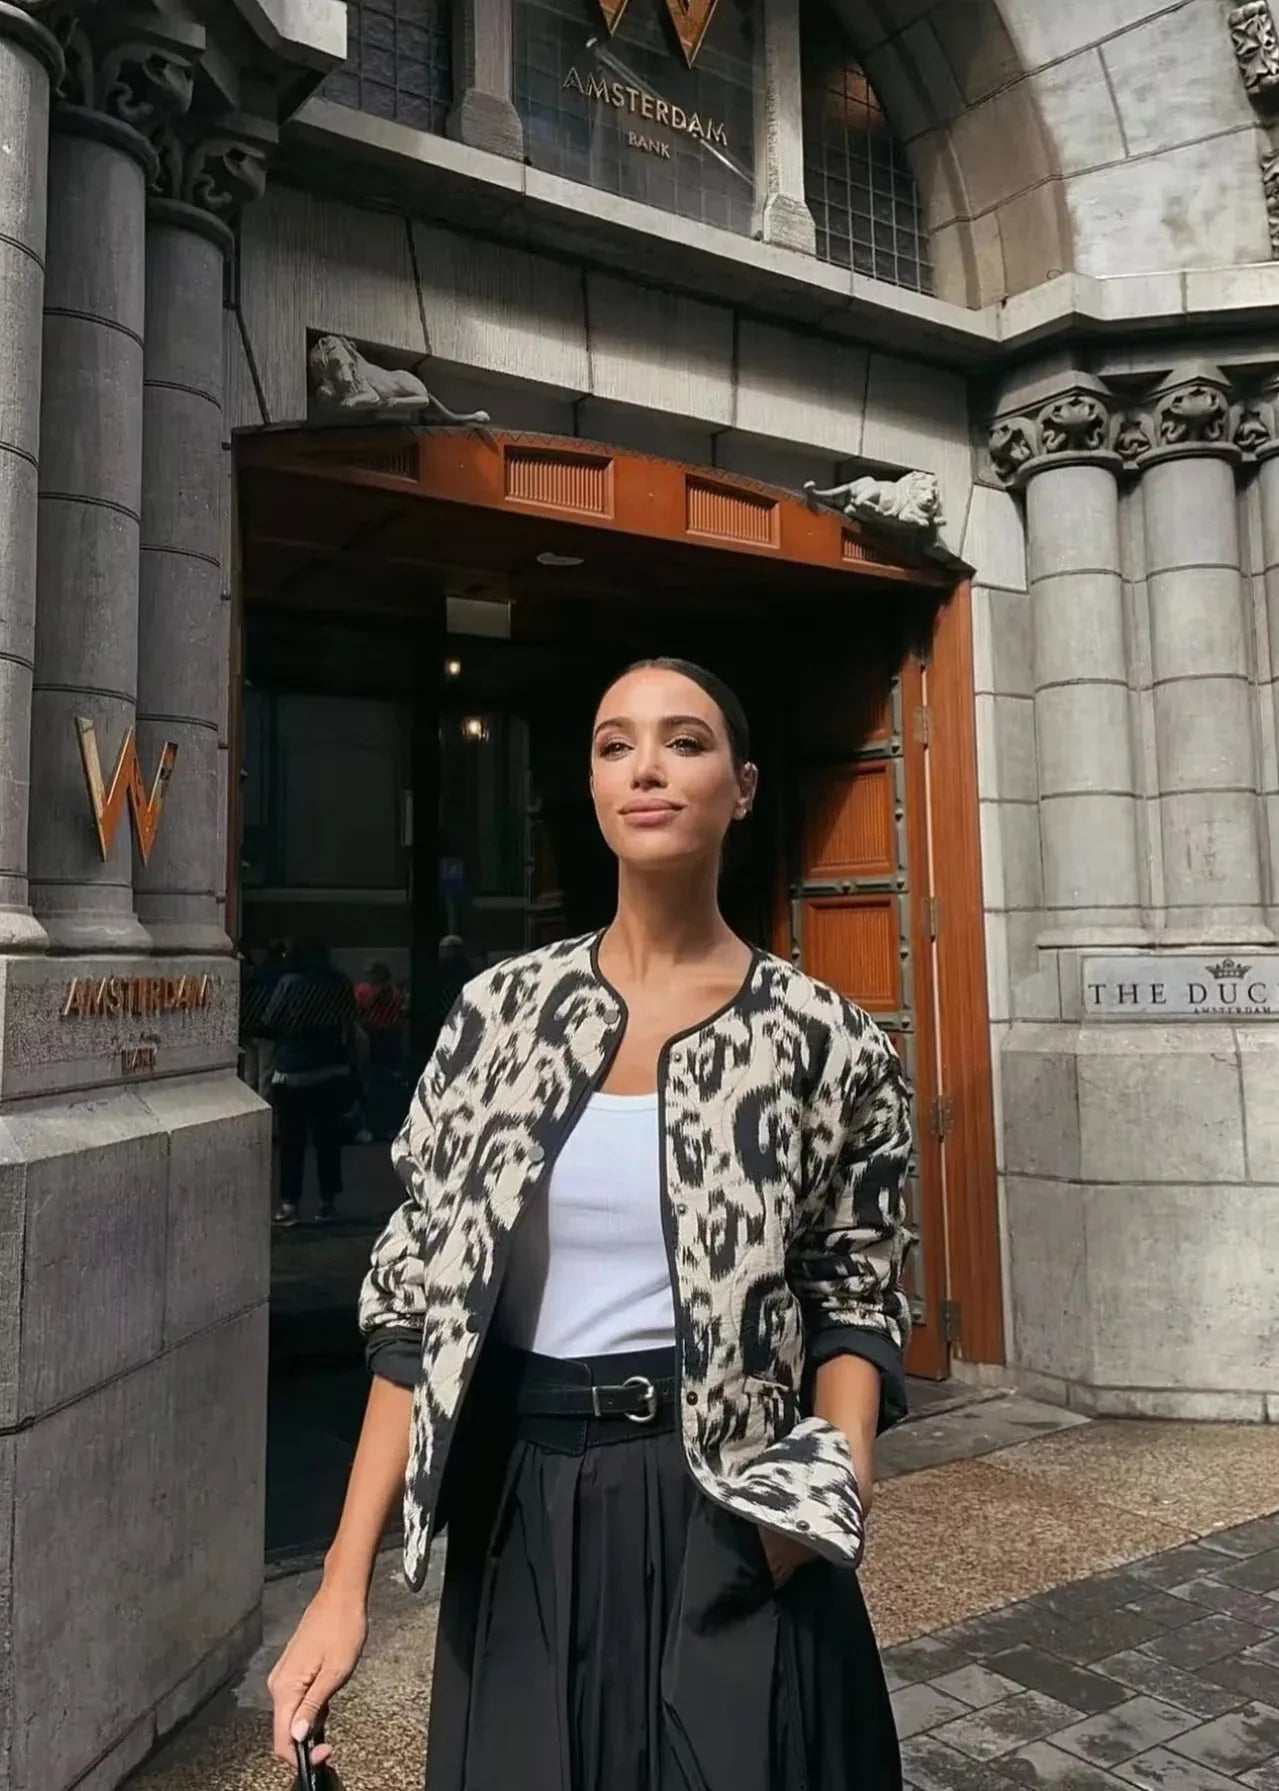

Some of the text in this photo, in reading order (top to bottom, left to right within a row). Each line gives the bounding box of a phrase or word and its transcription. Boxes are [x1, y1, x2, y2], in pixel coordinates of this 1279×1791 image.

[562, 66, 728, 147] AMSTERDAM
[627, 130, 671, 159] BANK
[75, 716, 179, 868] W
[1088, 982, 1279, 1005] THE DUC
[1193, 1006, 1271, 1015] AMSTERDAM
